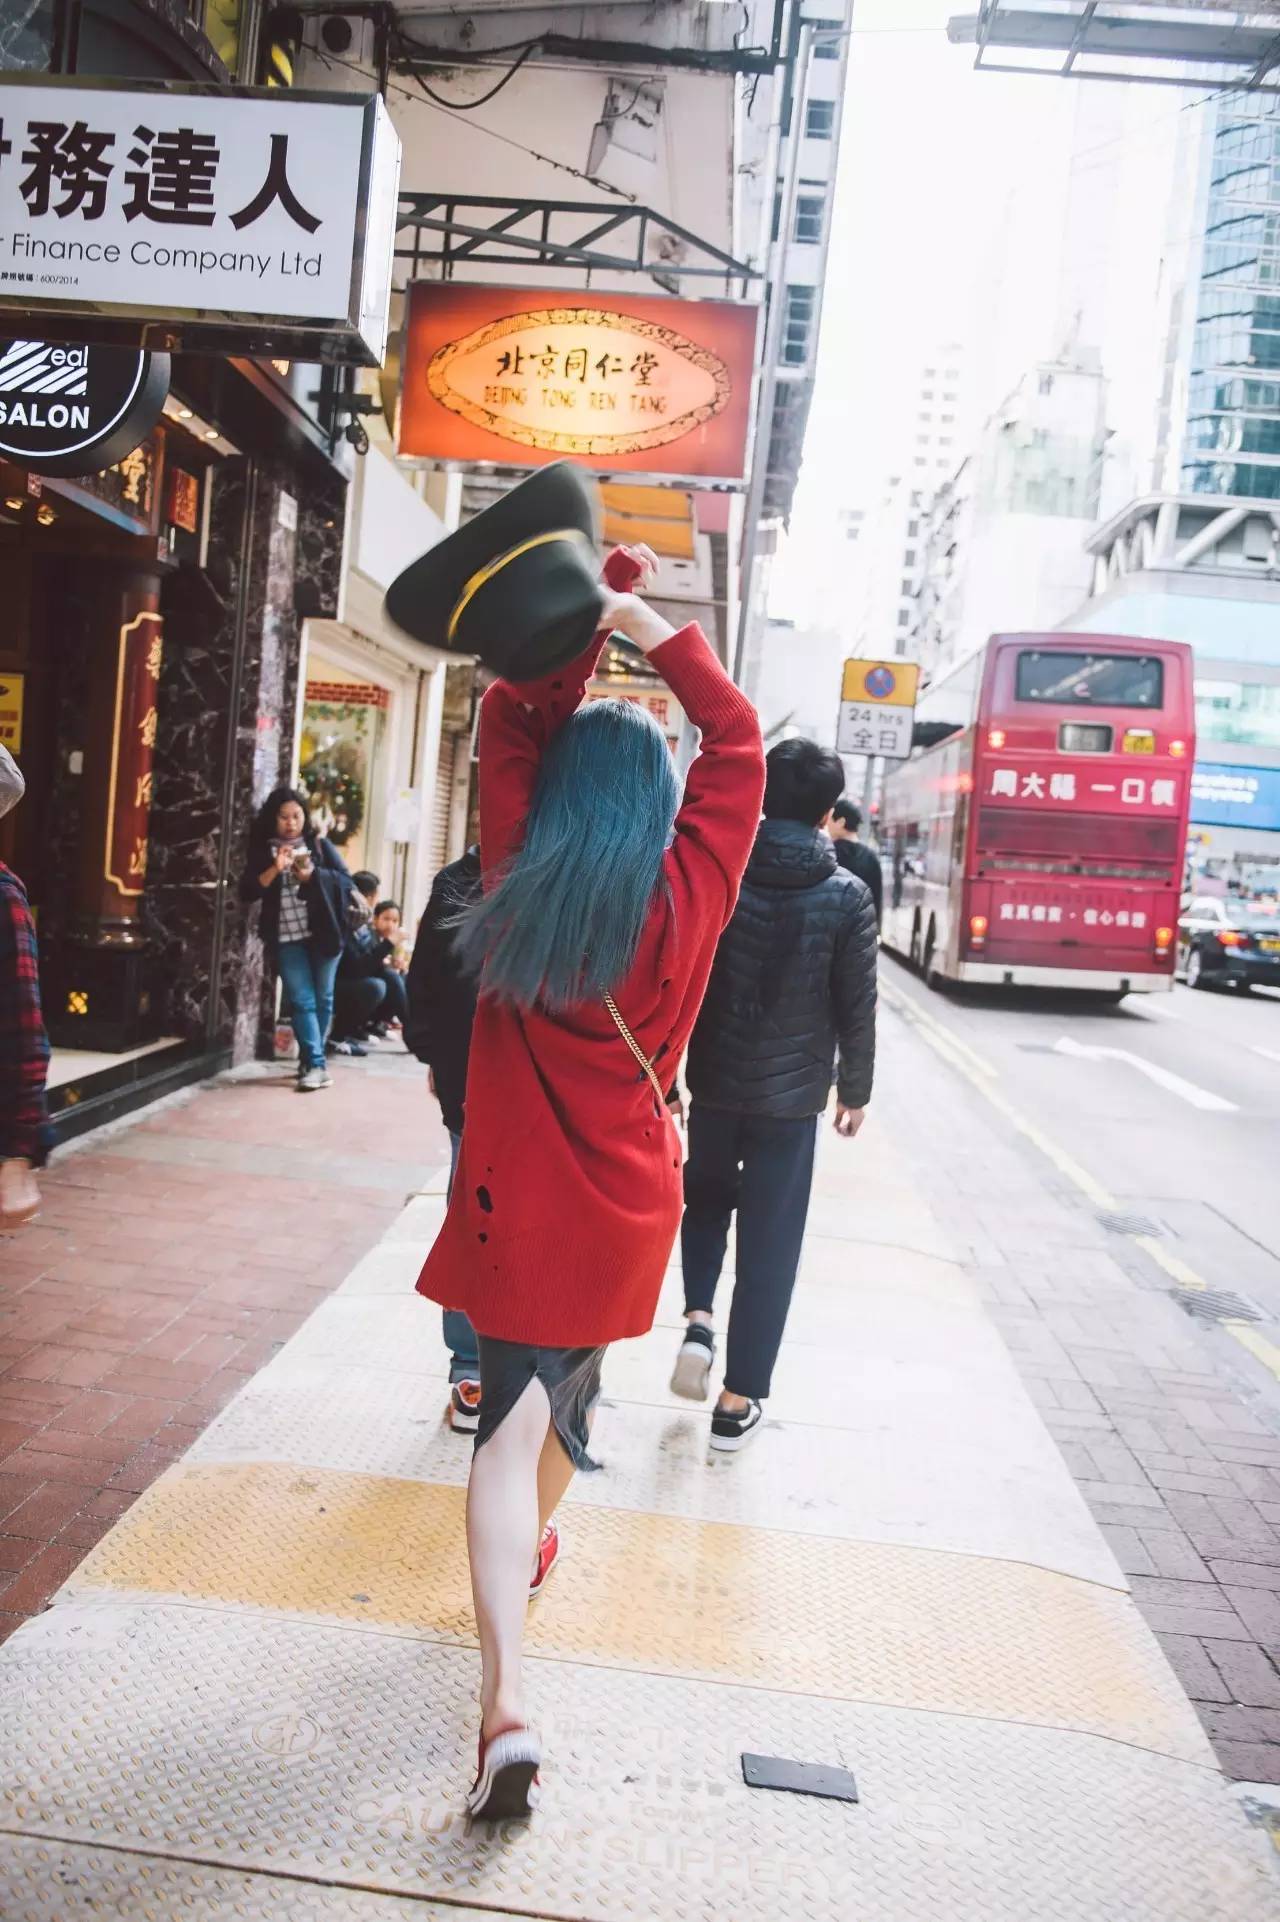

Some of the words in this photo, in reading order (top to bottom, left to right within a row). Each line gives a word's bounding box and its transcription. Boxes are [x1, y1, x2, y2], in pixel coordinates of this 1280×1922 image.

[12, 233, 120, 263] Finance
[130, 241, 272, 279] Company
[280, 251, 323, 277] Ltd
[495, 344, 659, 387] 北京同仁堂
[848, 707, 872, 722] 24
[878, 712, 904, 726] hrs
[852, 727, 898, 750] 全日
